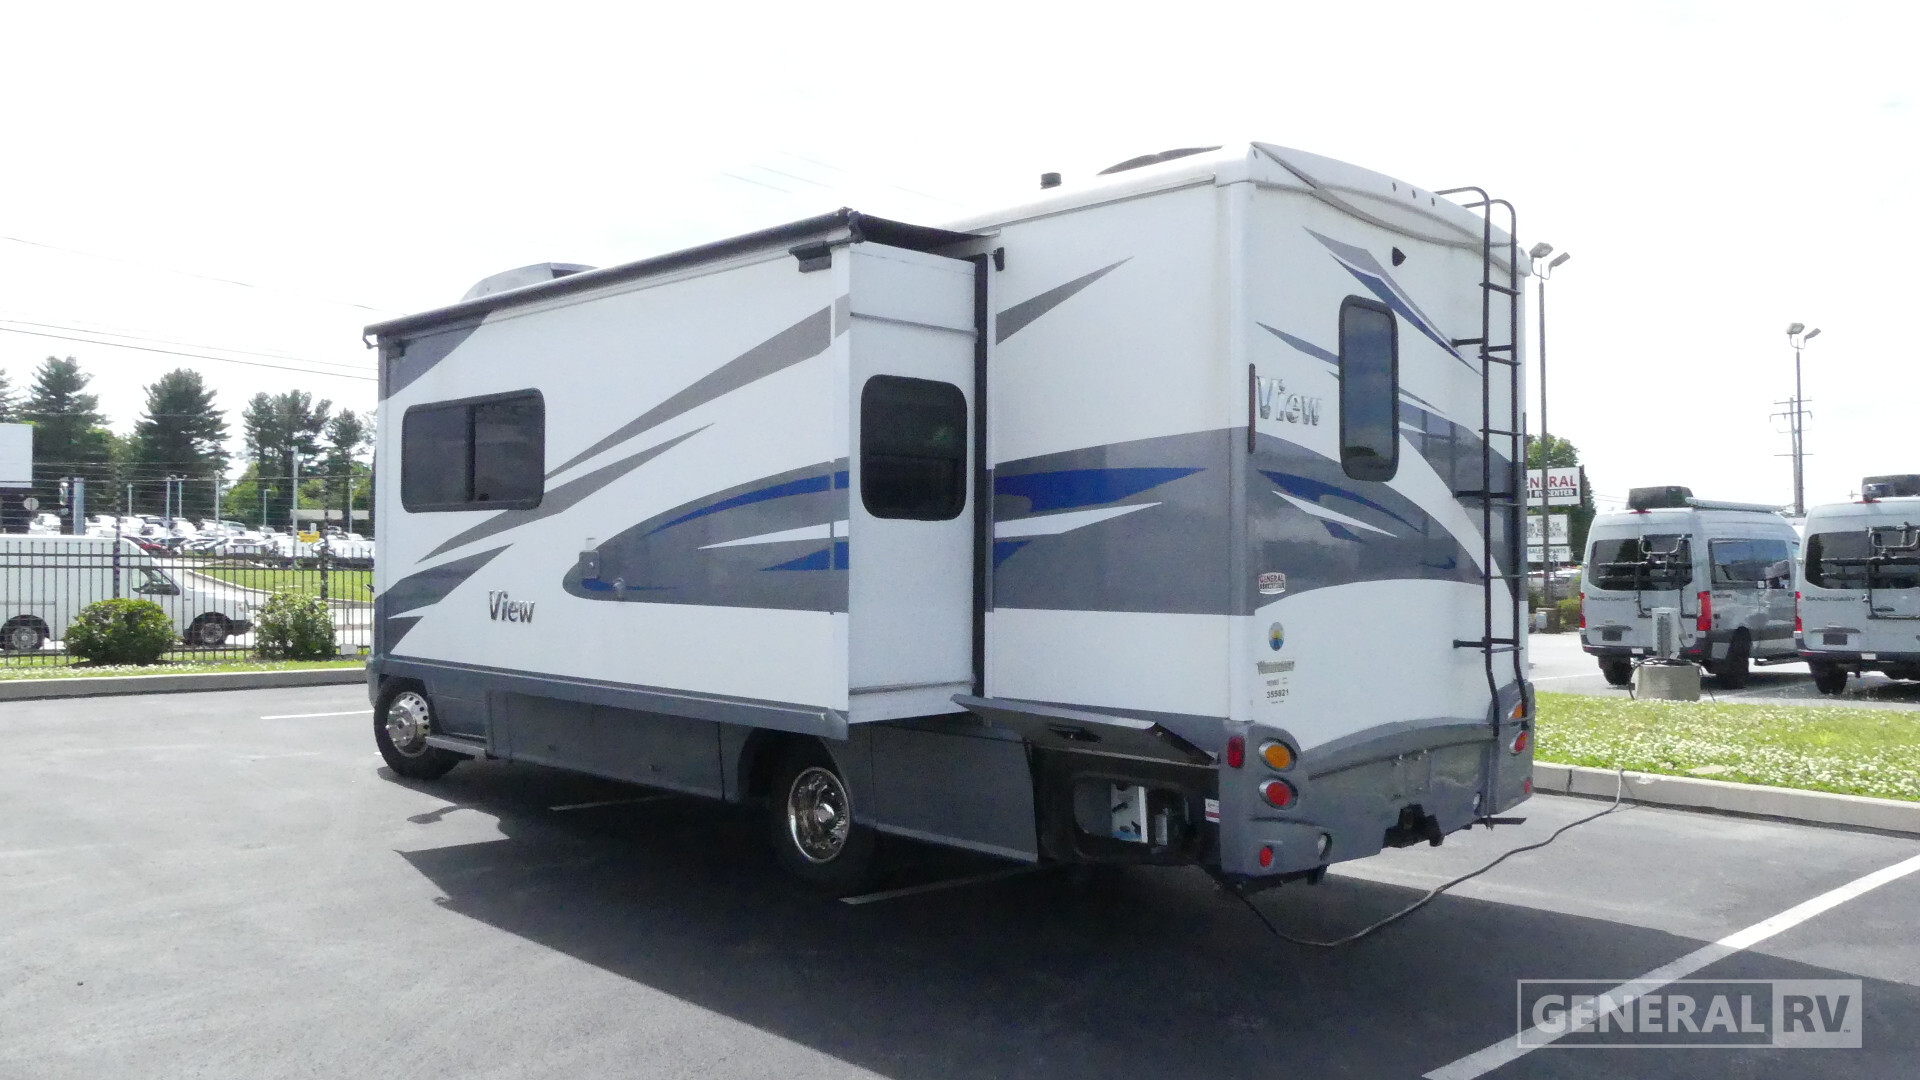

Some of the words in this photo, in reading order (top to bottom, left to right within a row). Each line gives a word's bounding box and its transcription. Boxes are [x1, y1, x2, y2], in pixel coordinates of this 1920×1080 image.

[1256, 375, 1322, 427] View
[1527, 475, 1577, 488] NRAL
[1548, 489, 1574, 497] CENTER
[489, 589, 536, 624] View
